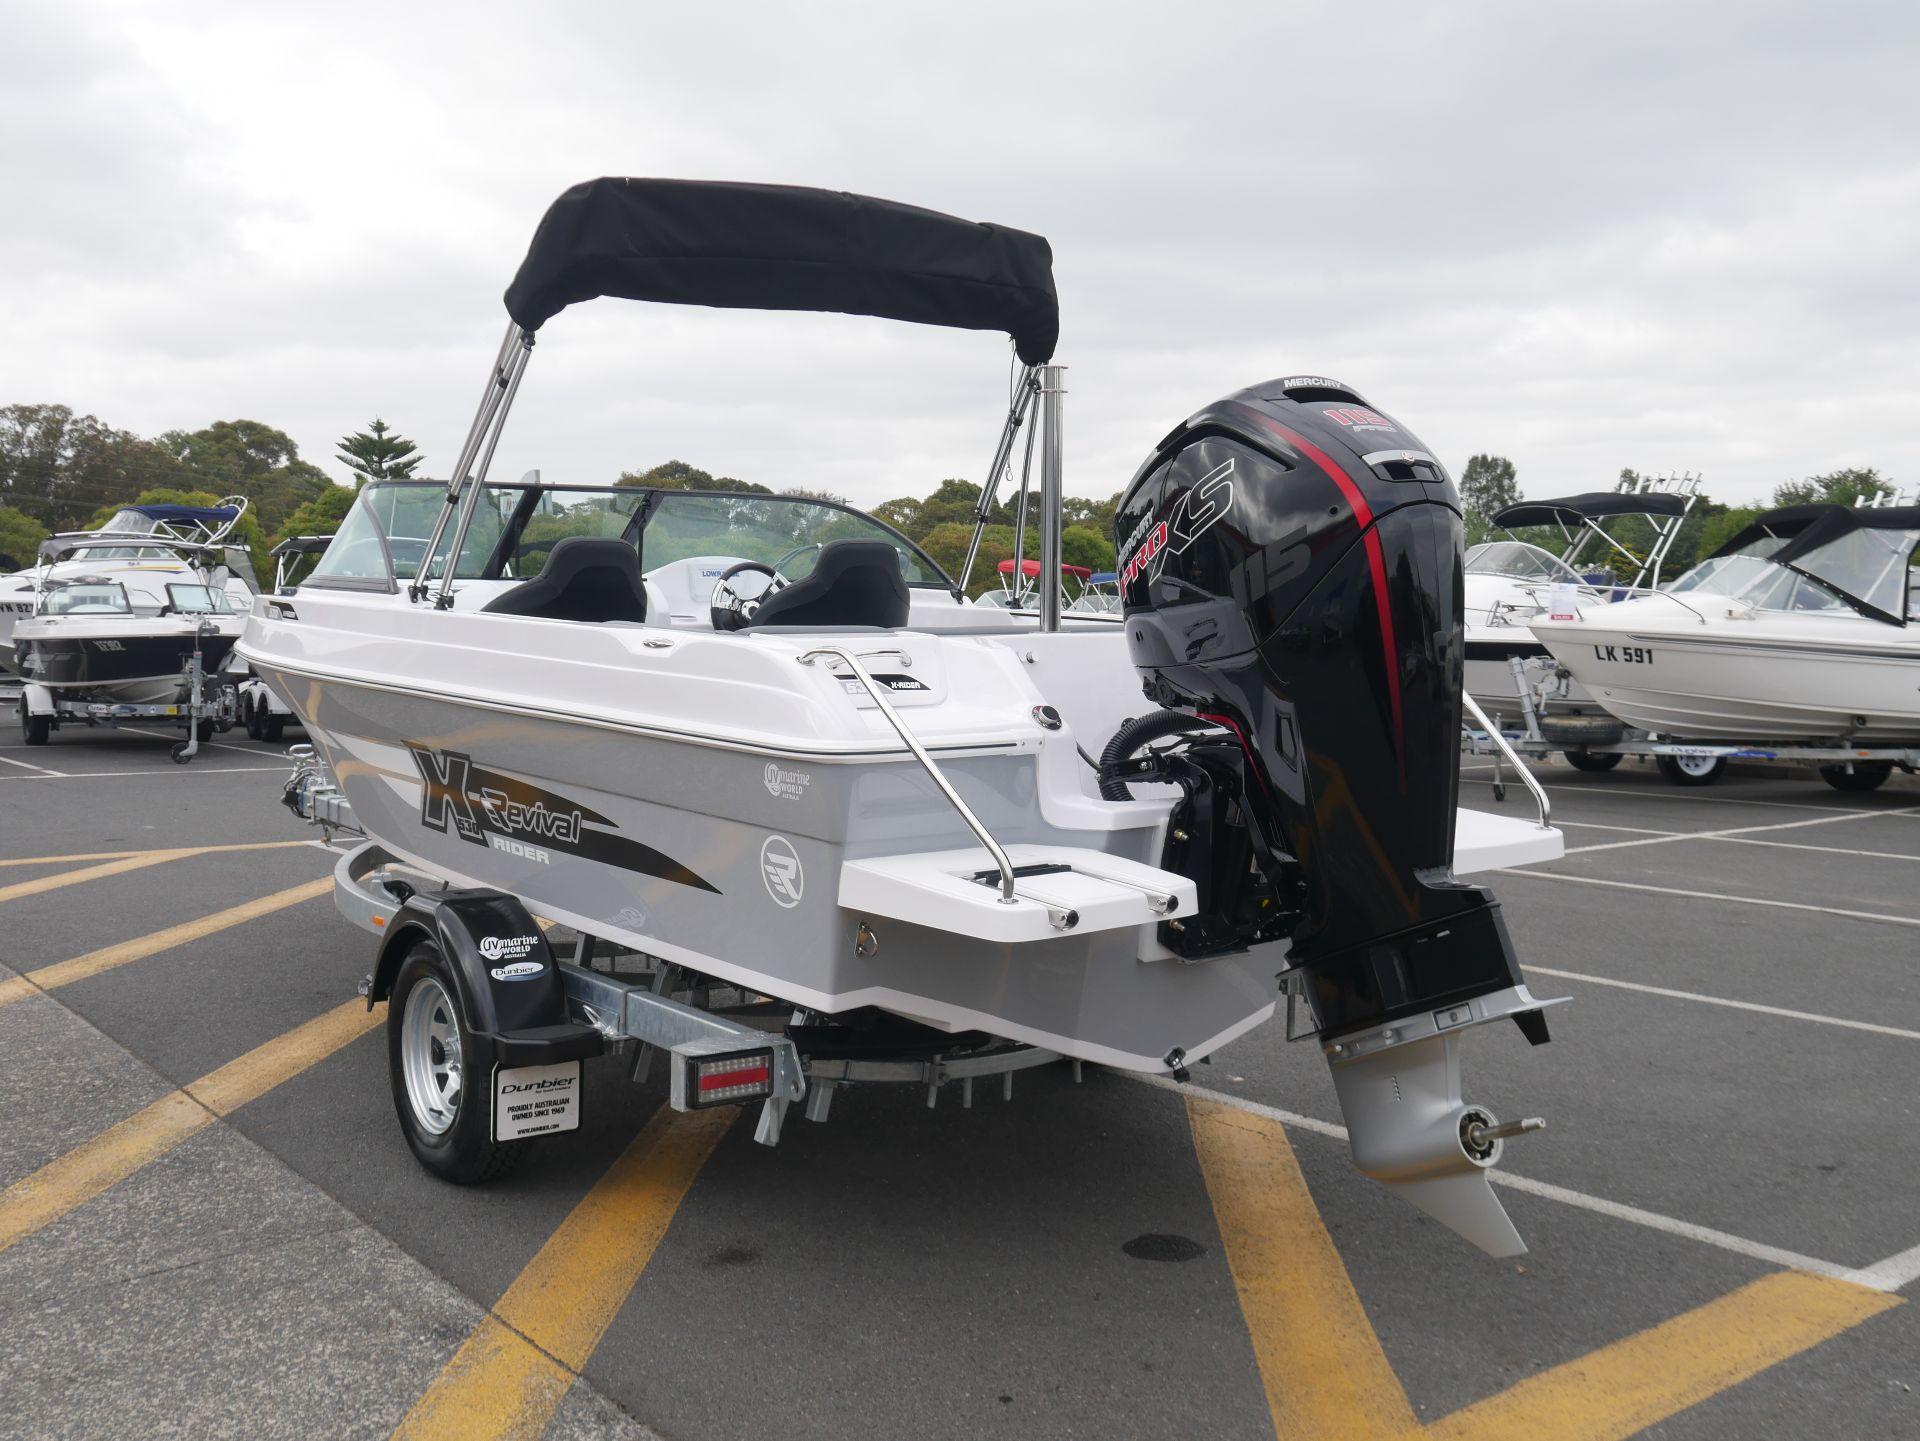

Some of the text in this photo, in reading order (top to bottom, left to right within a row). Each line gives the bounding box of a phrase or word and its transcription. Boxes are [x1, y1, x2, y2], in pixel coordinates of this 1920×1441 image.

[1284, 377, 1342, 388] MERCURY
[1323, 408, 1391, 426] 115
[1120, 457, 1235, 601] PRO XS
[1594, 645, 1653, 664] LK 591
[890, 681, 921, 689] X-RIDER
[779, 782, 803, 795] WORLD
[493, 836, 550, 865] RIDER
[501, 945, 531, 955] WORLD
[495, 967, 534, 976] Dunbier
[501, 1077, 577, 1095] Dunbier
[507, 1097, 570, 1114] PROUDLY AUSTRALIAN
[511, 1106, 565, 1121] OWNED SINCE 1969
